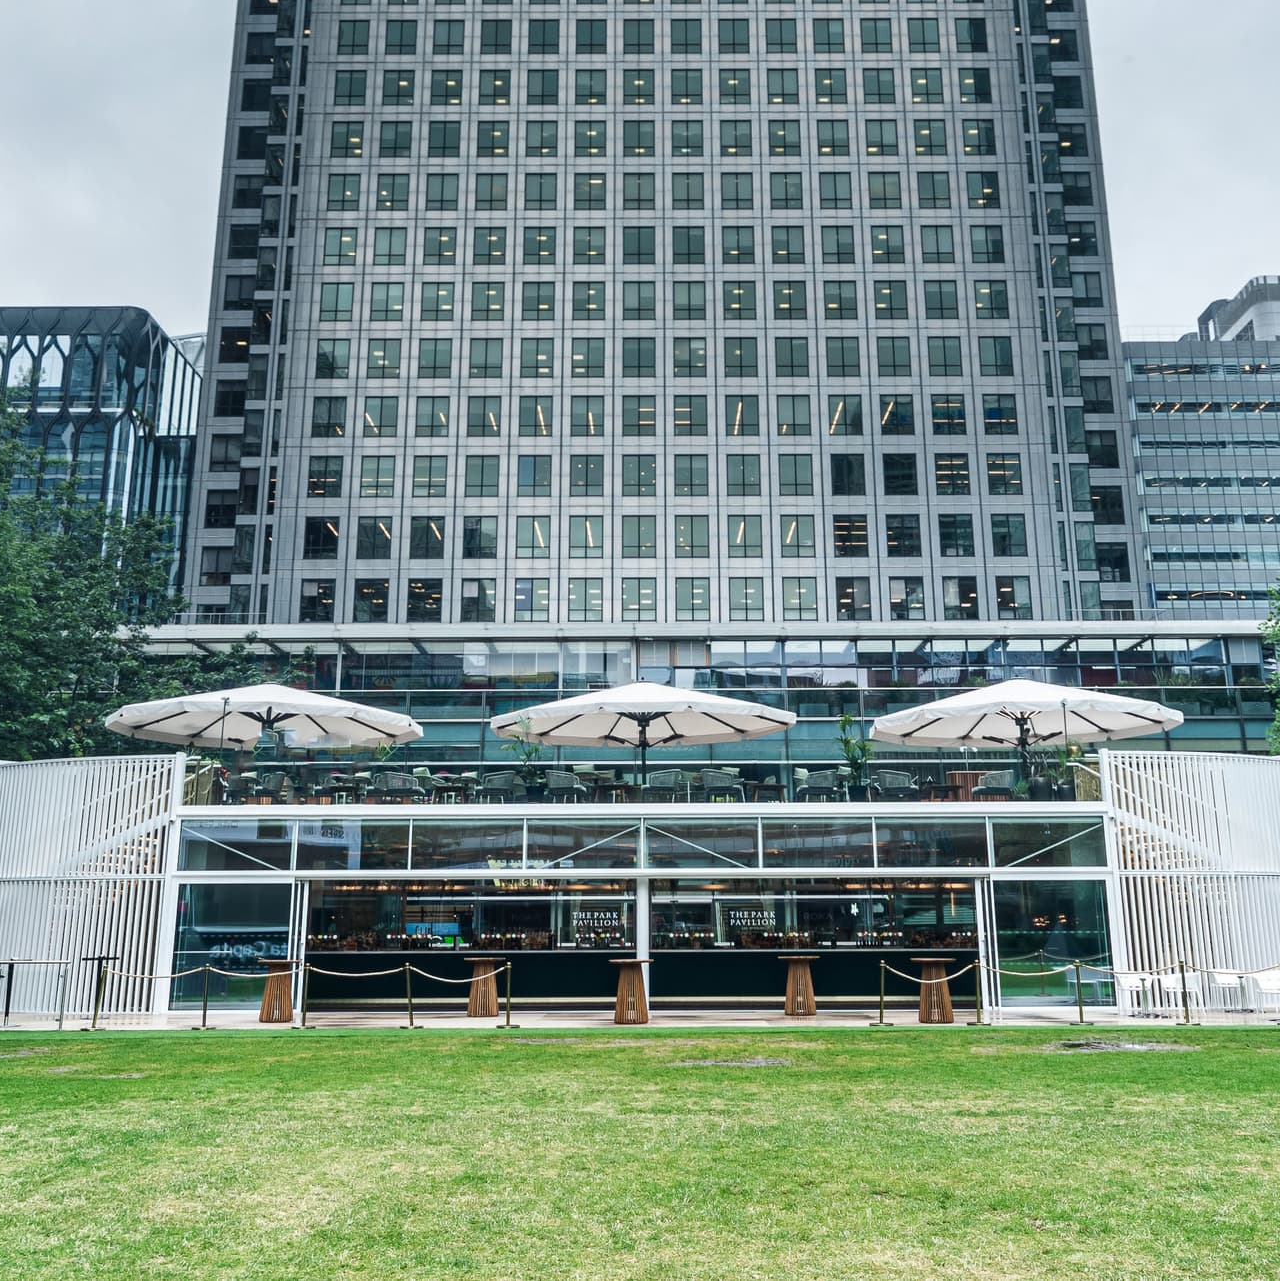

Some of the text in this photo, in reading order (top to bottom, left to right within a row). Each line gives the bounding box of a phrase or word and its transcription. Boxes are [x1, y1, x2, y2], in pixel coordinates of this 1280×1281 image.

[572, 911, 618, 919] THE PARK
[729, 910, 776, 919] THE PARK
[572, 919, 619, 927] PAVILION
[730, 918, 776, 926] PAVILION
